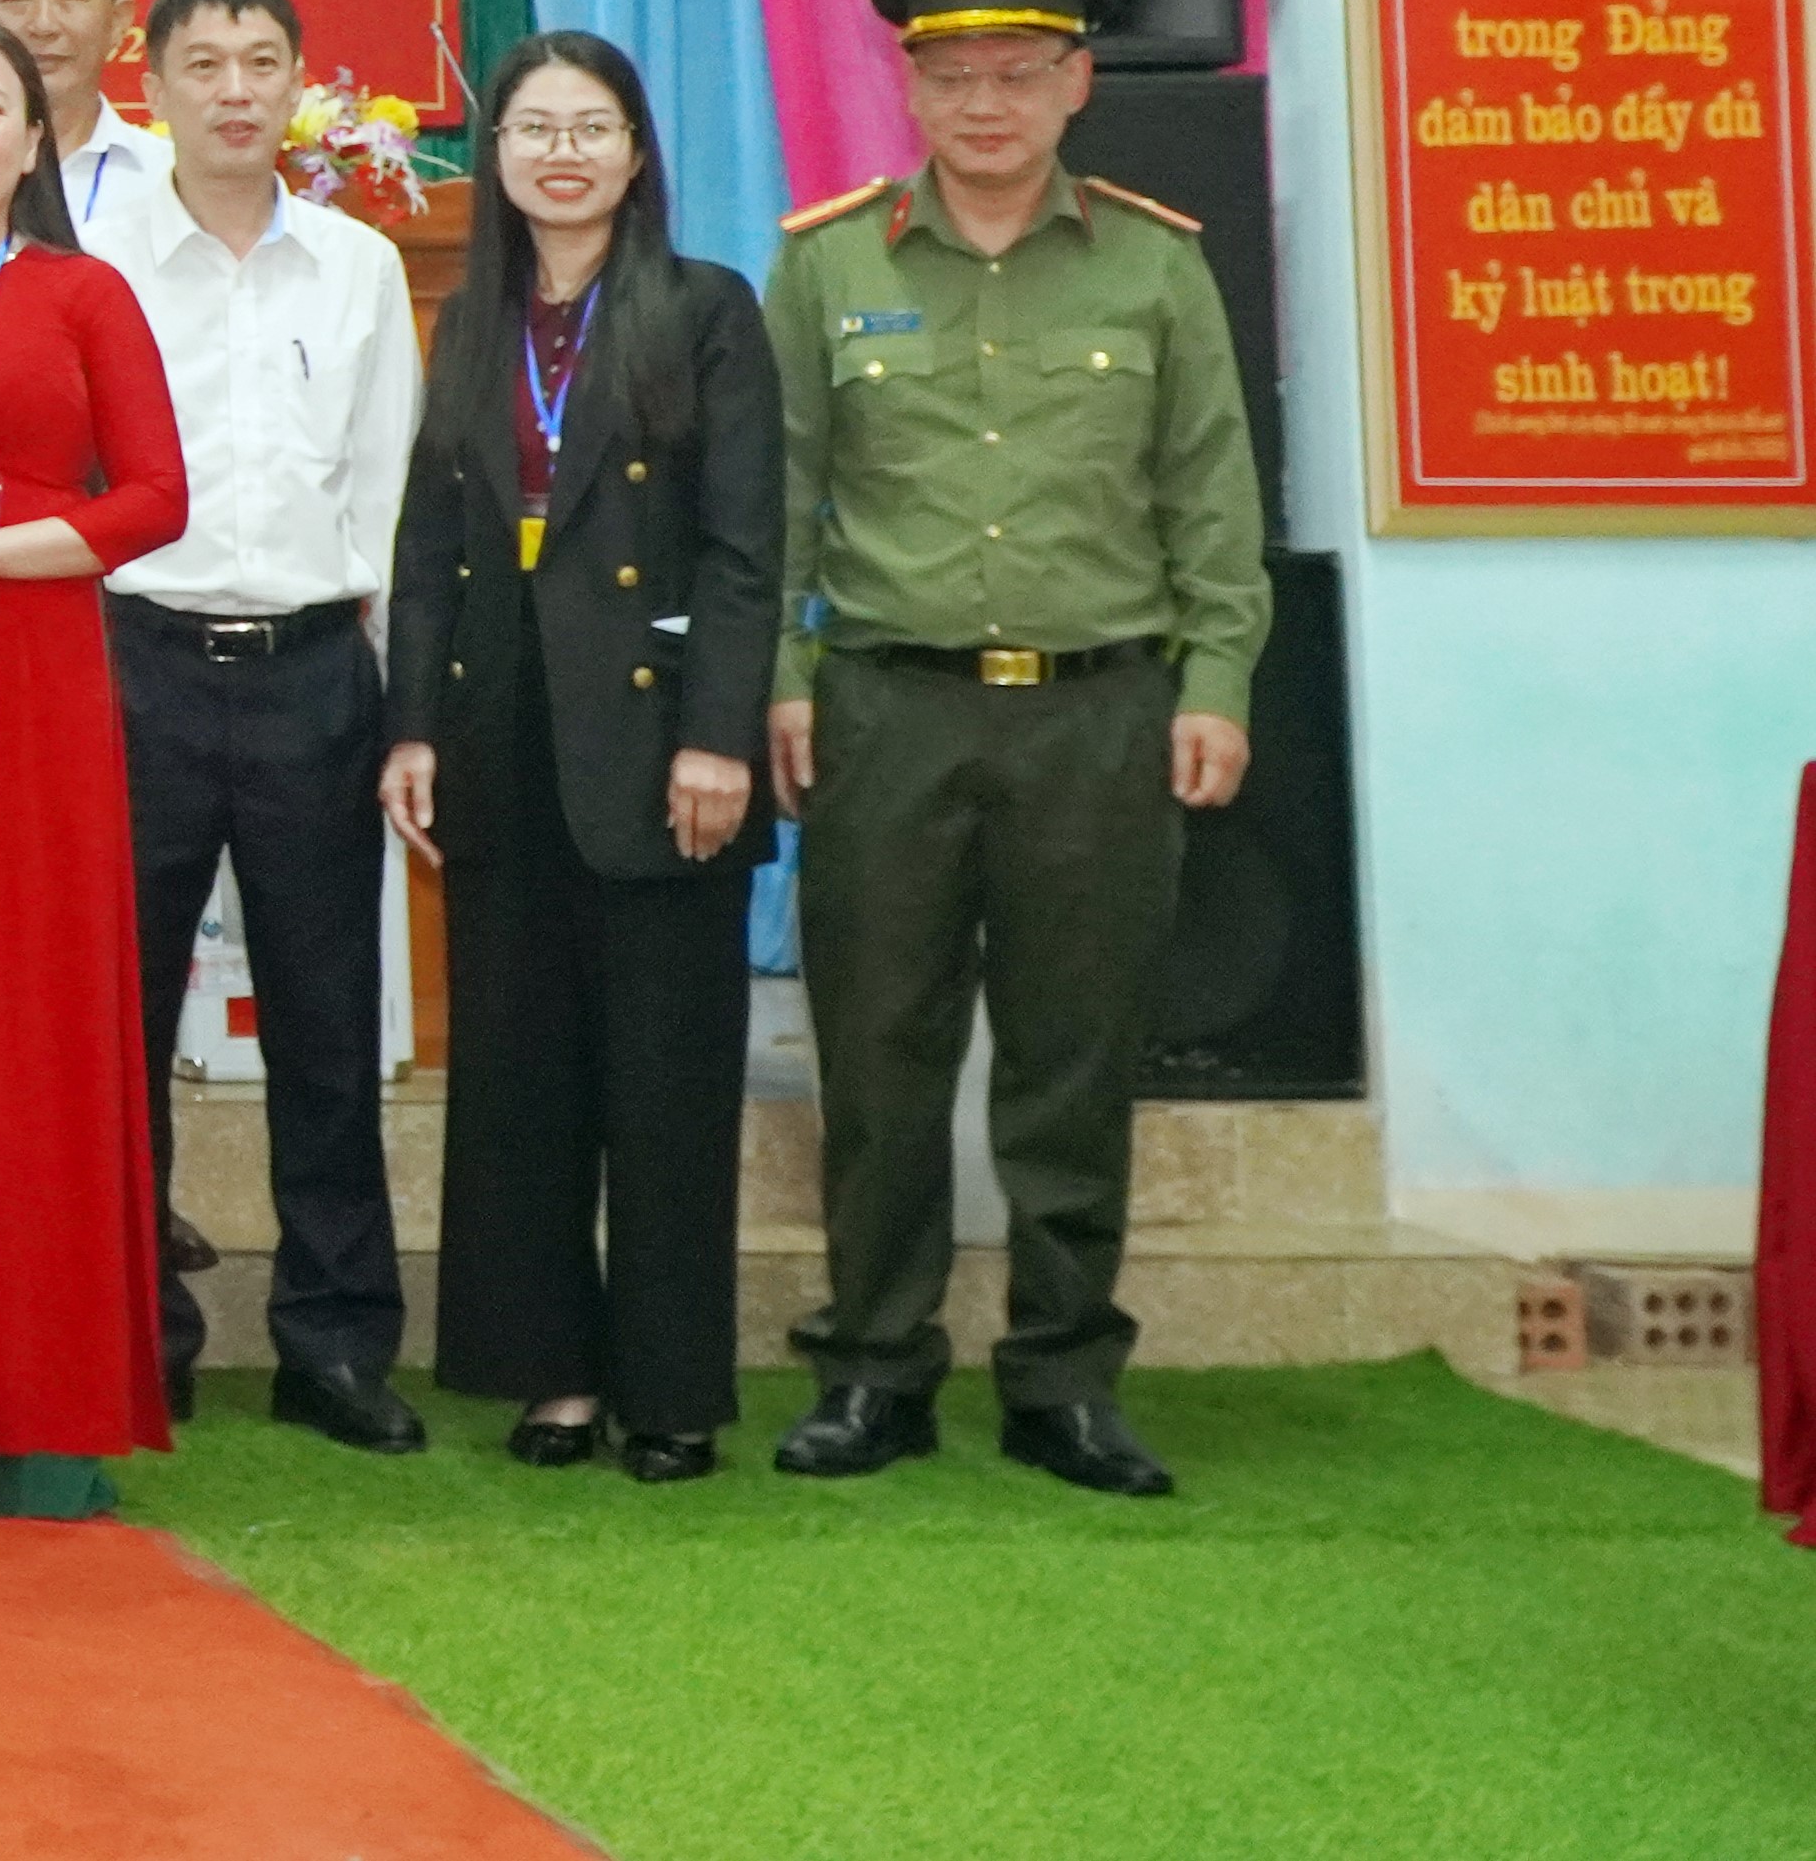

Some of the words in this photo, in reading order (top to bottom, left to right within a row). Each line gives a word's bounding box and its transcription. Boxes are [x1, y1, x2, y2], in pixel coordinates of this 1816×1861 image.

[1451, 9, 1584, 73] trong
[1525, 84, 1600, 143] bảo
[1567, 167, 1654, 230] chủ
[1517, 263, 1614, 328] luật
[1623, 266, 1757, 326] trong
[1493, 351, 1599, 403] sinh
